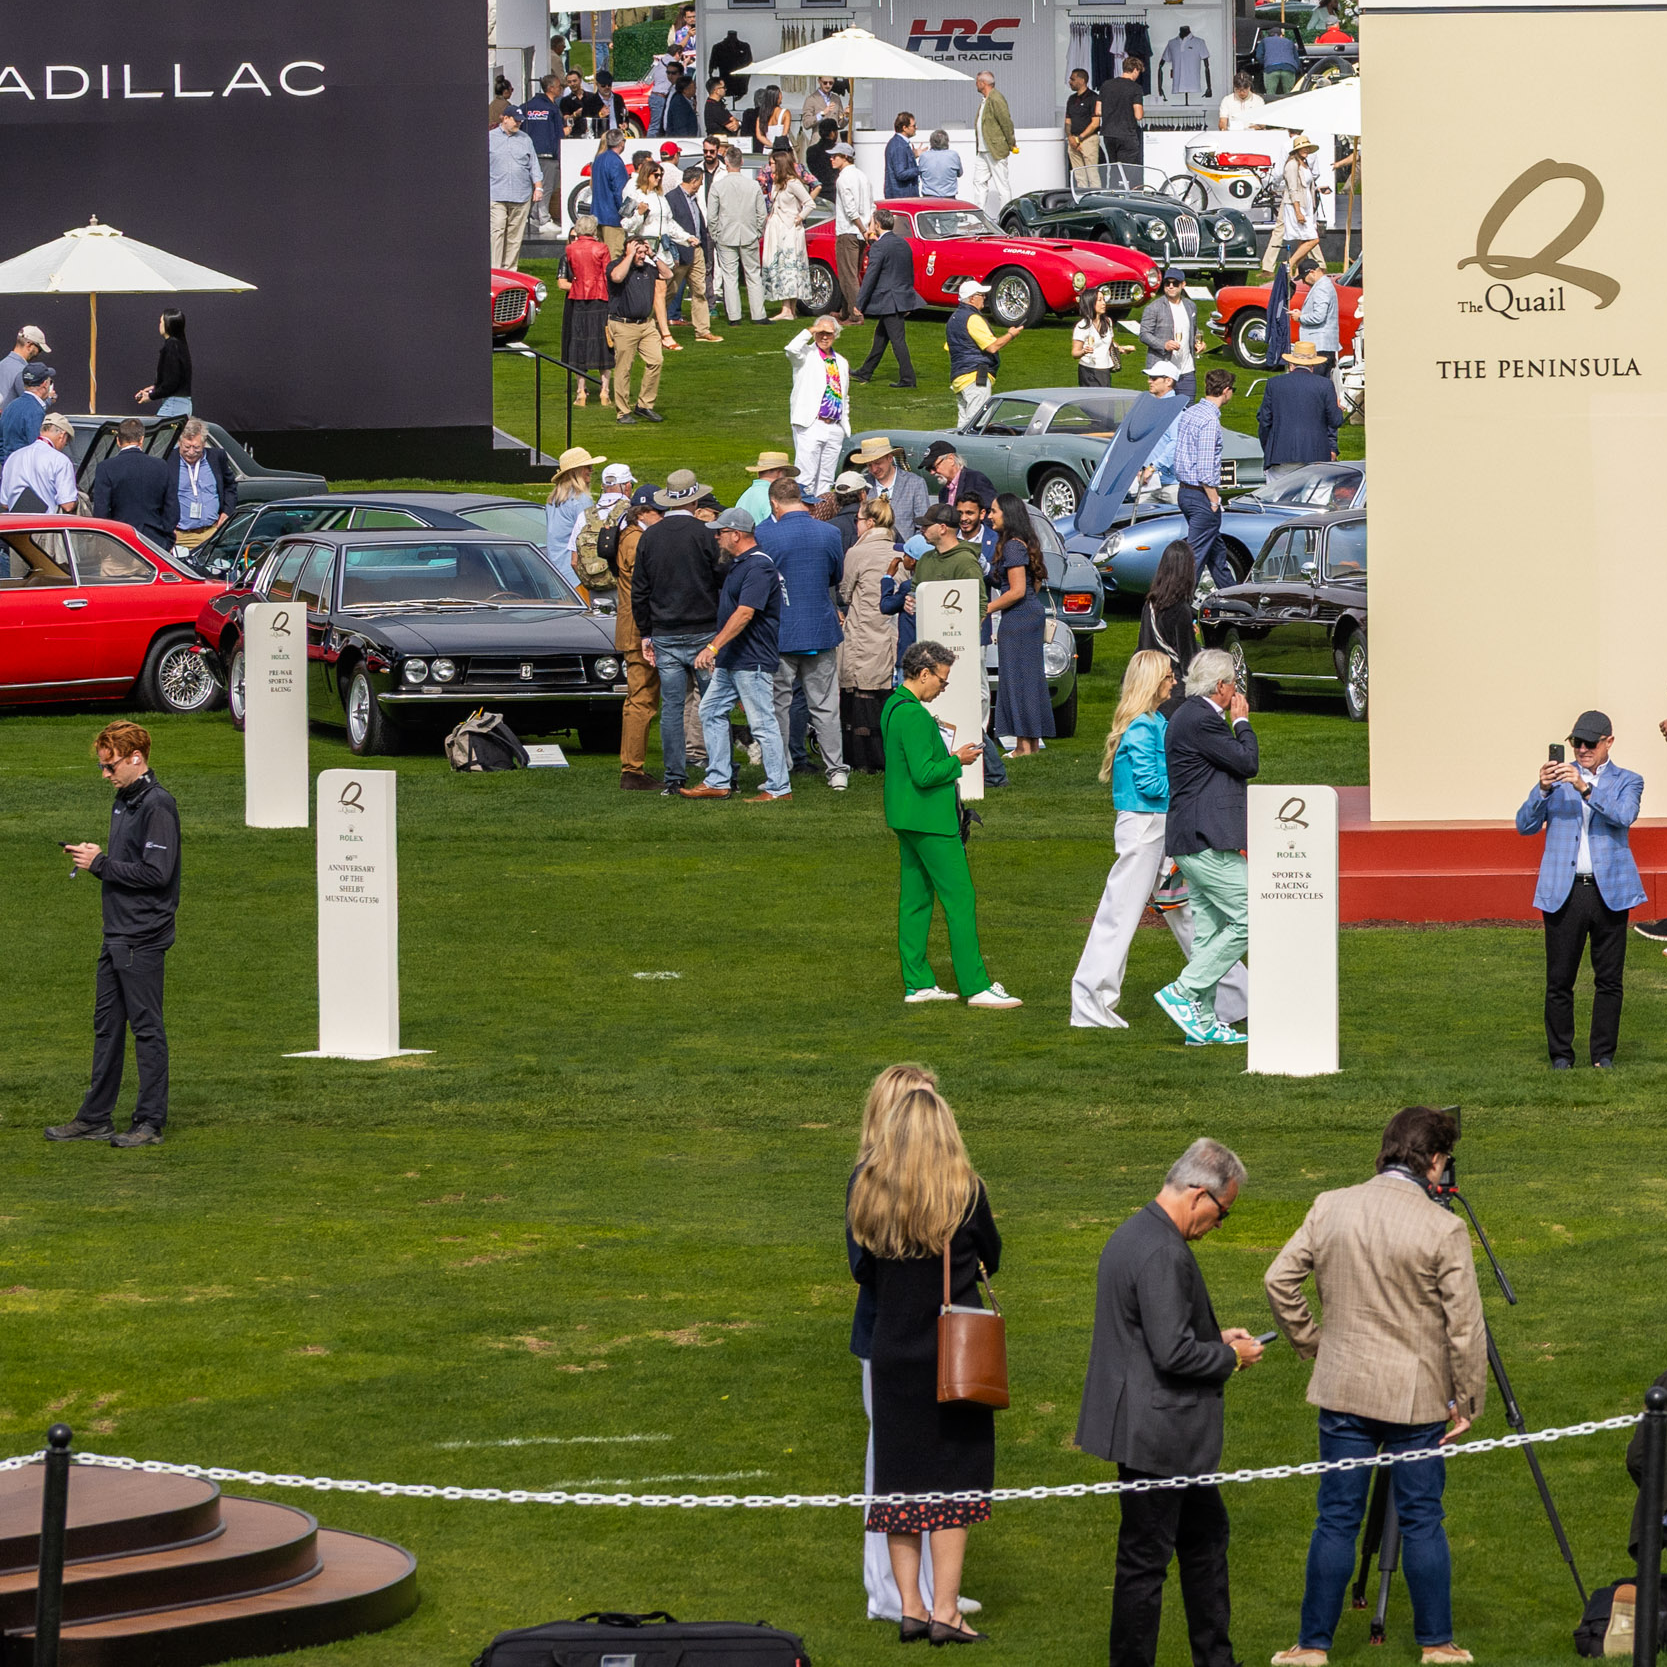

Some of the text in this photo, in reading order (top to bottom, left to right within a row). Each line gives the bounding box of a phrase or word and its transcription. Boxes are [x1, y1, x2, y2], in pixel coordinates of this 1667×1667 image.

[905, 18, 1022, 52] HRC
[957, 53, 1013, 61] RACING
[0, 60, 326, 101] ADILLAC
[1236, 181, 1245, 196] 6
[1457, 283, 1566, 321] The Quail
[1436, 357, 1643, 380] THE PENINSULA
[339, 834, 364, 842] ROLEX
[1276, 851, 1307, 859] ROLEX
[327, 864, 376, 873] ANNIVERSARY
[350, 875, 364, 883] THE
[1271, 871, 1304, 879] SPORTS
[339, 885, 365, 893] SHELBY
[325, 895, 358, 903] MUSTANG
[1260, 892, 1324, 900] MOTORCYCLES
